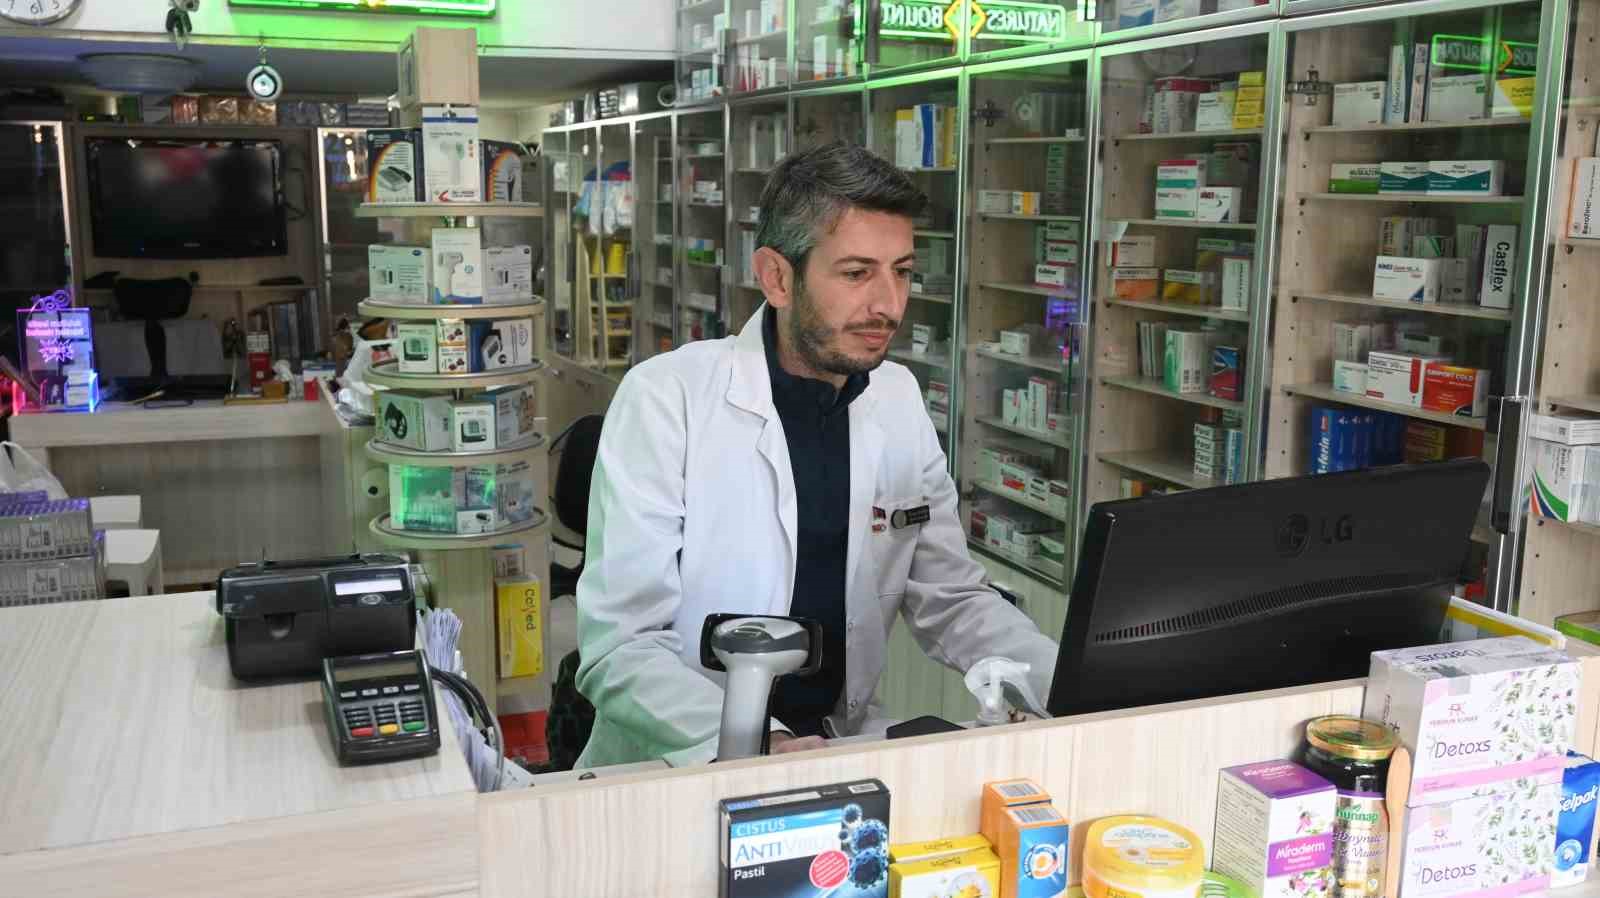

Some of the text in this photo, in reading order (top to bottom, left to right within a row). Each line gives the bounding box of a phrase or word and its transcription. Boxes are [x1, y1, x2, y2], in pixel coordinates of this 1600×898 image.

[1492, 241, 1510, 293] Casflex
[1320, 513, 1352, 544] LG
[1434, 739, 1492, 759] Detoxs
[736, 817, 786, 836] CISTUS
[1275, 841, 1326, 861] Miraderm
[733, 866, 766, 881] Pastil
[1421, 863, 1477, 885] Detoxs
